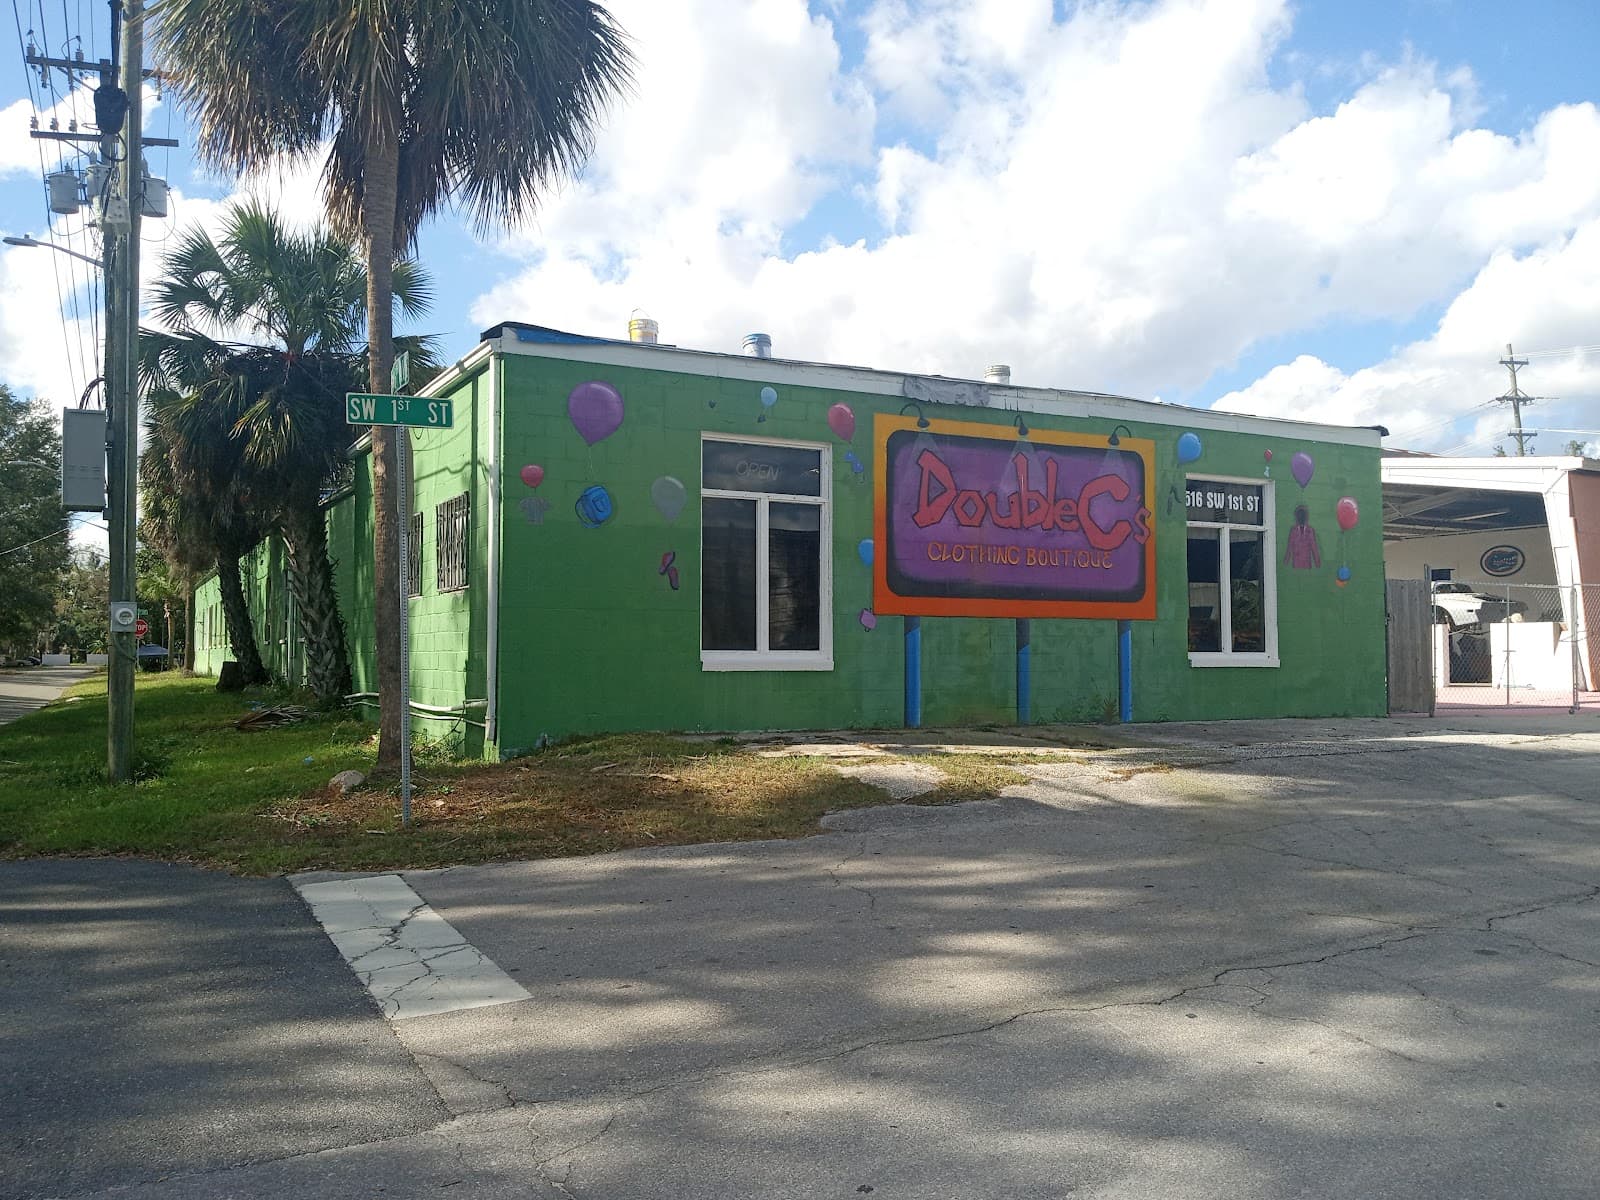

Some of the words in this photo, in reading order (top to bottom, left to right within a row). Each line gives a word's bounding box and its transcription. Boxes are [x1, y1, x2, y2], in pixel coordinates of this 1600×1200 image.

[350, 397, 376, 421] SW
[391, 399, 411, 422] 1ST
[427, 401, 449, 425] ST
[736, 460, 779, 481] OPEN
[1186, 490, 1203, 508] 516
[1206, 491, 1225, 509] SW
[1246, 495, 1260, 513] ST
